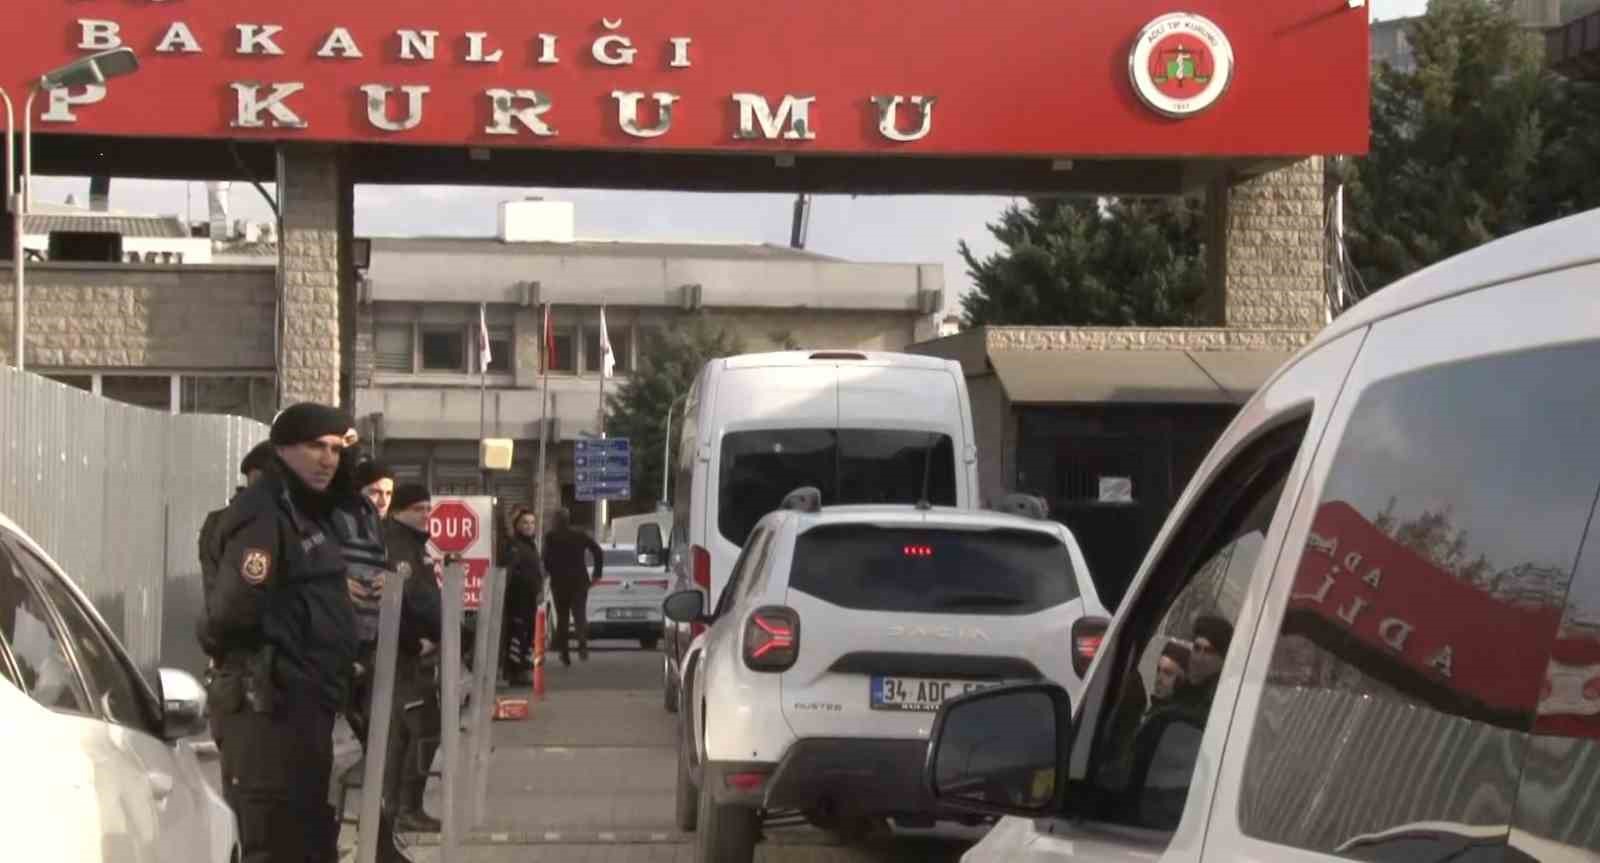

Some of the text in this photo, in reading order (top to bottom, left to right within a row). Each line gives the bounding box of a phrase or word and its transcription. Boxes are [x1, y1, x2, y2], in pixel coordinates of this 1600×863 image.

[77, 17, 692, 68] BAKANLIĞI
[229, 81, 935, 142] KURUMU
[430, 517, 473, 538] DUR
[885, 679, 907, 701] 34
